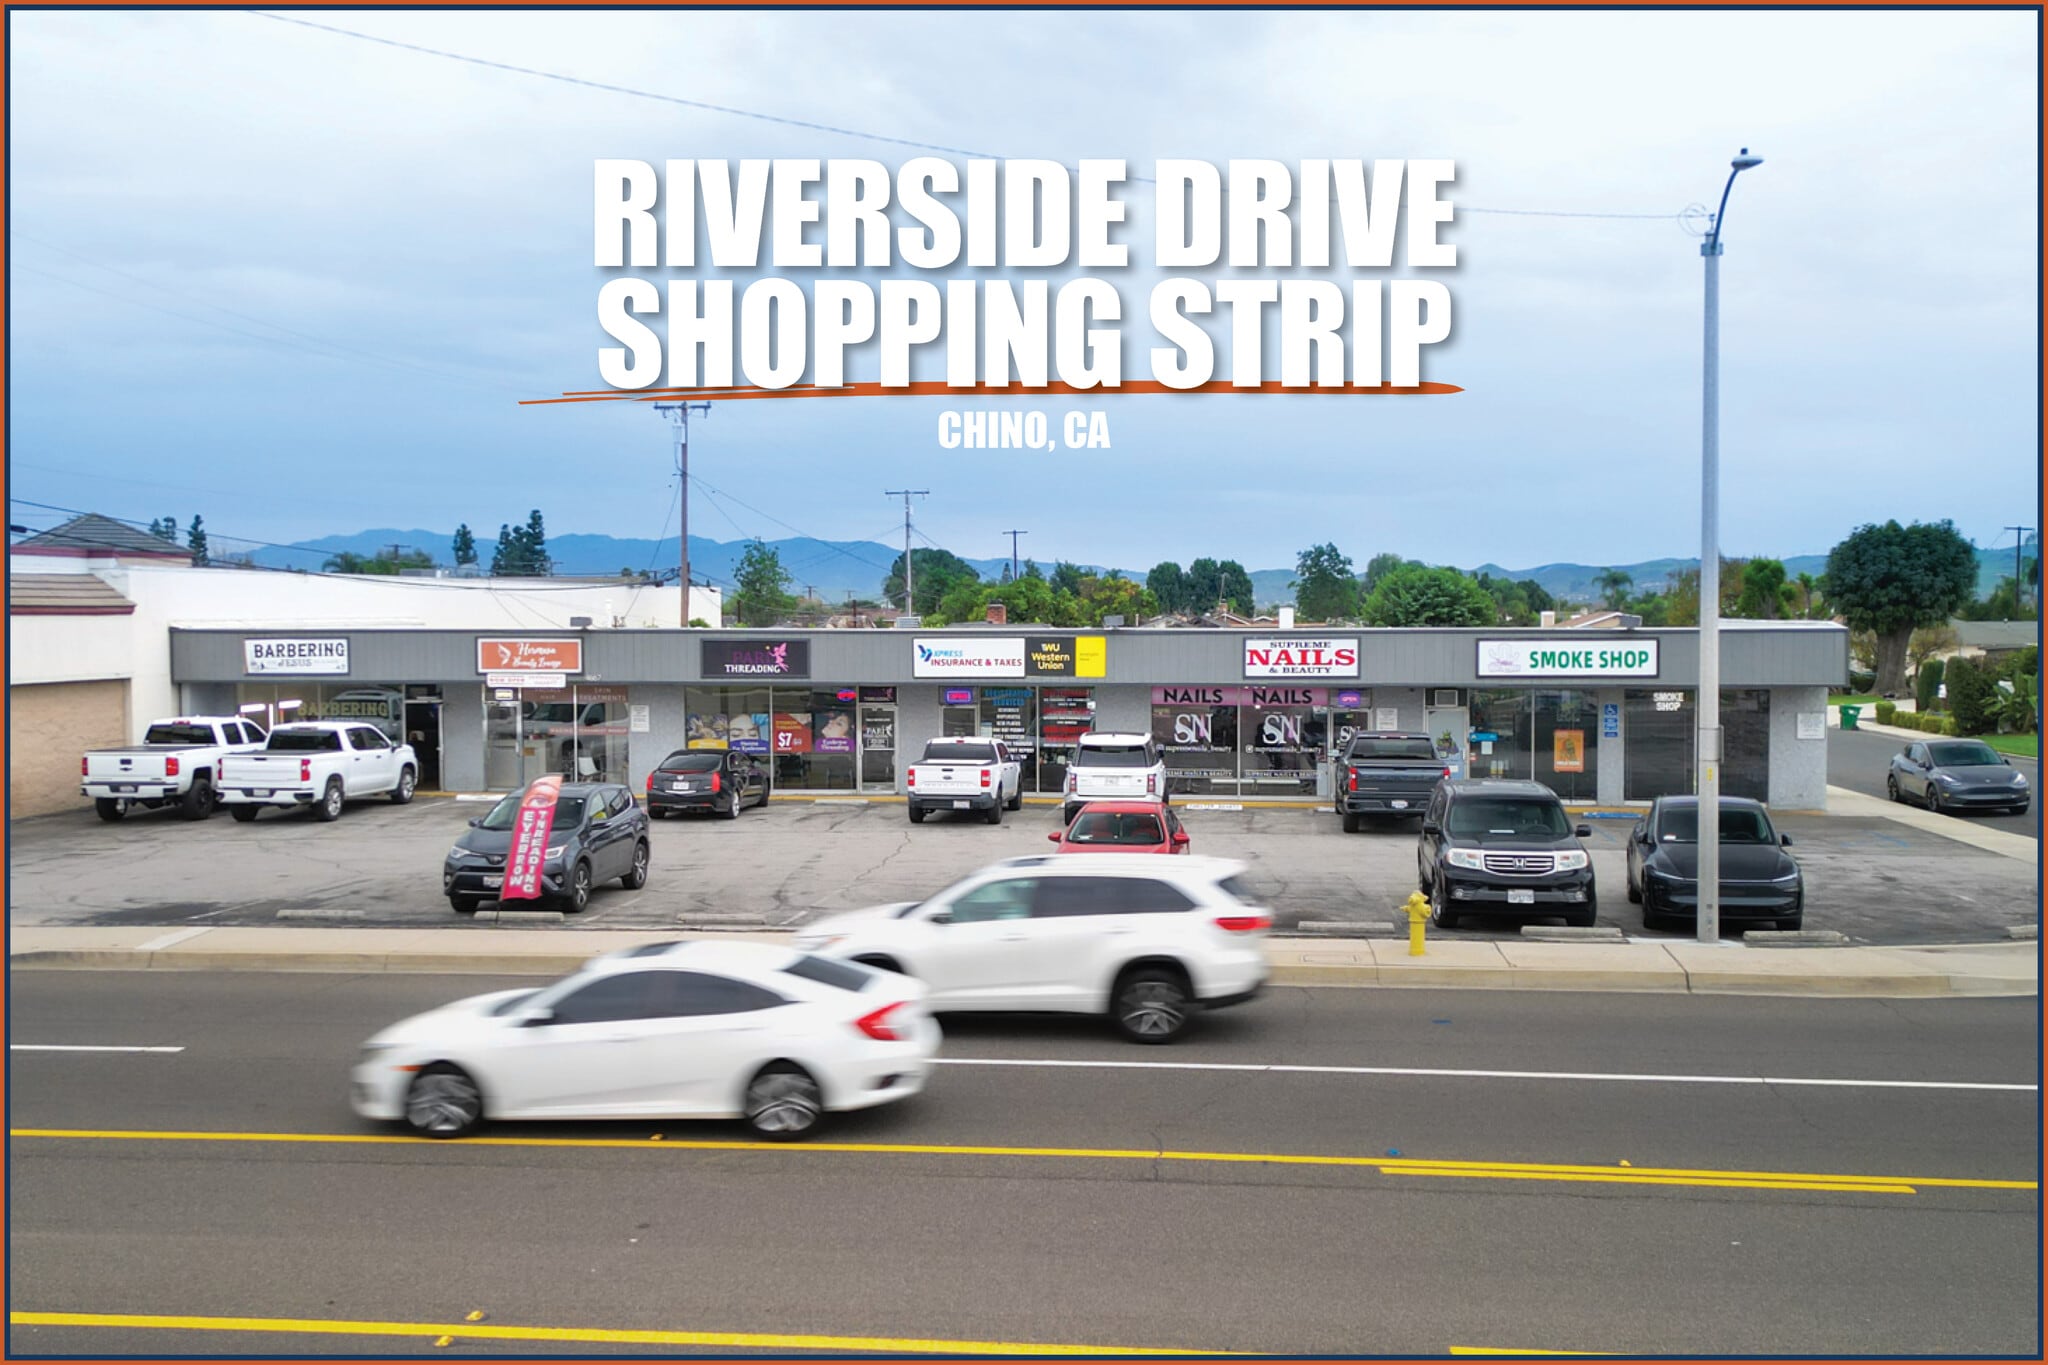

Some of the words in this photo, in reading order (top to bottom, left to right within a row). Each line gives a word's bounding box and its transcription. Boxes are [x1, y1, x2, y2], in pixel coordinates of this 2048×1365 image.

[254, 643, 345, 658] BARBERING
[1042, 643, 1060, 652] WU
[1270, 641, 1331, 649] SUPREME
[732, 650, 771, 664] PARI
[931, 658, 983, 666] INSURANCE
[1031, 653, 1070, 662] Western
[1247, 649, 1356, 666] NAILS
[1529, 651, 1593, 669] SMOKE
[1598, 651, 1649, 669] SHOP
[724, 664, 781, 673] THREADING
[1037, 662, 1064, 670] Union
[1164, 689, 1223, 703] NAILS
[1252, 690, 1312, 704] NAILS
[1653, 692, 1684, 701] SMOKE
[298, 700, 389, 717] BARBERING
[1656, 702, 1680, 711] SHOP
[1174, 713, 1213, 744] SN
[1262, 714, 1302, 744] SN
[778, 732, 792, 747] $7
[509, 811, 536, 886] EYEBROW
[523, 810, 548, 893] THREADING
